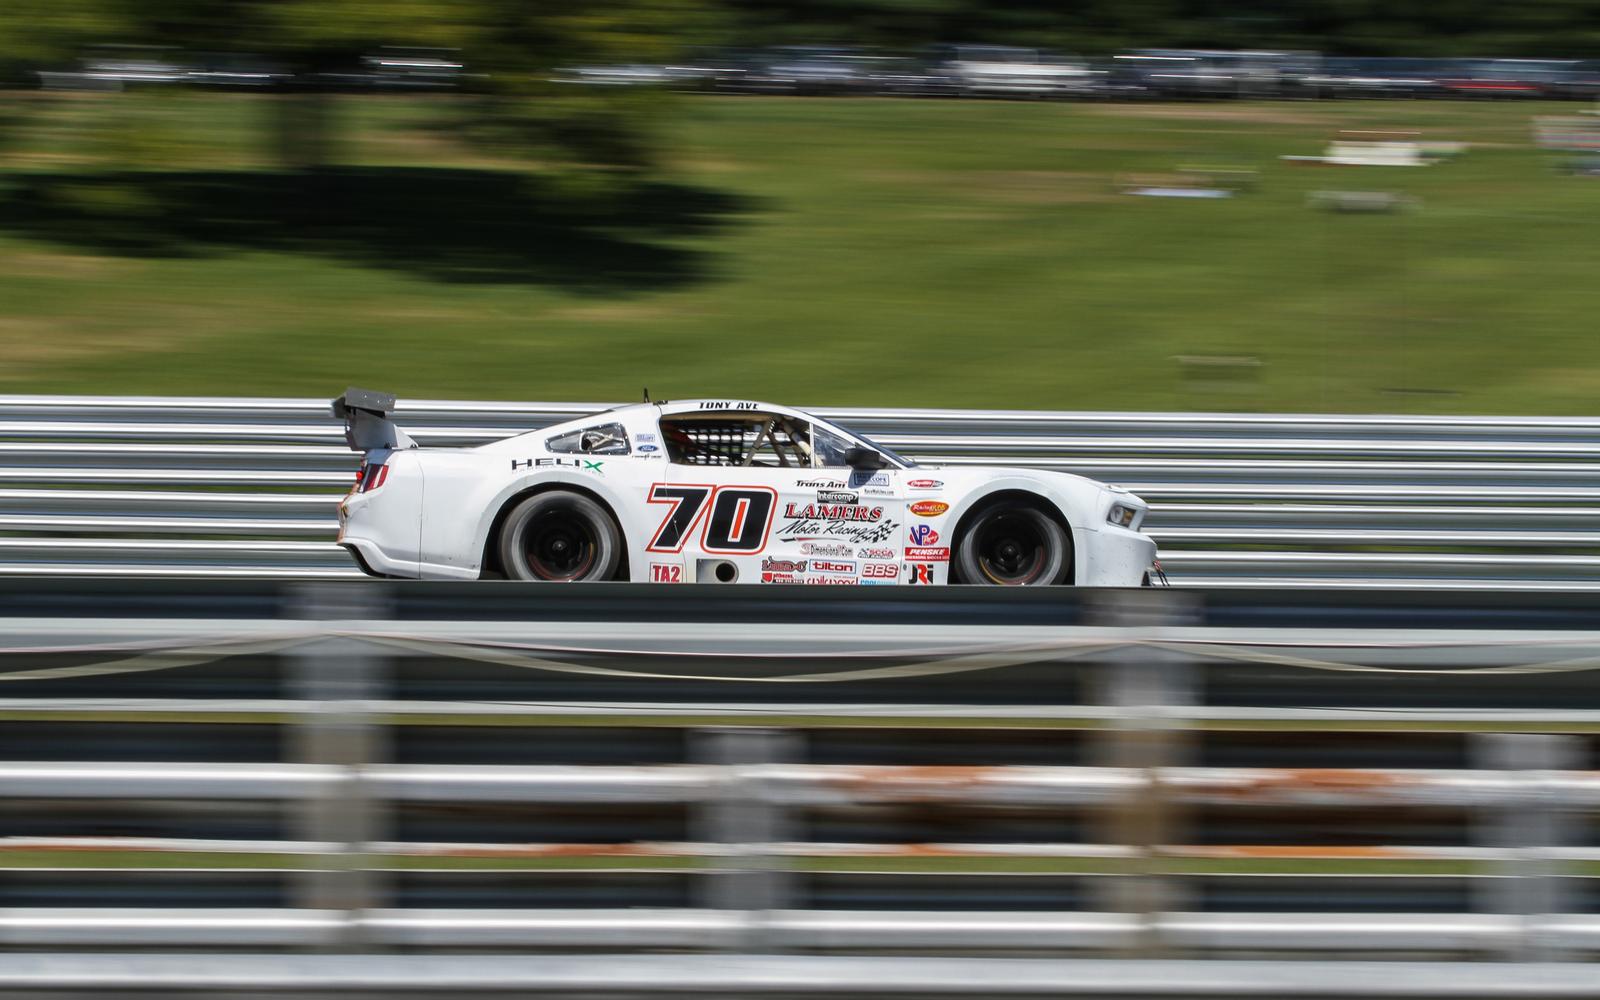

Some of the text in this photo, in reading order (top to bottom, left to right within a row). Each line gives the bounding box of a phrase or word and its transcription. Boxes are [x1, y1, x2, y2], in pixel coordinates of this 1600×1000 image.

[699, 402, 731, 410] TONY
[512, 457, 605, 473] HELIX
[796, 480, 846, 488] Trans Am
[818, 491, 854, 501] Intercomp
[645, 482, 778, 556] 70
[784, 502, 884, 522] LAMERS
[776, 520, 869, 542] Motor Racing
[910, 524, 931, 546] VP
[869, 548, 894, 556] SCCA
[813, 561, 853, 571] tilton
[862, 563, 898, 578] BBS
[652, 565, 681, 583] TA2
